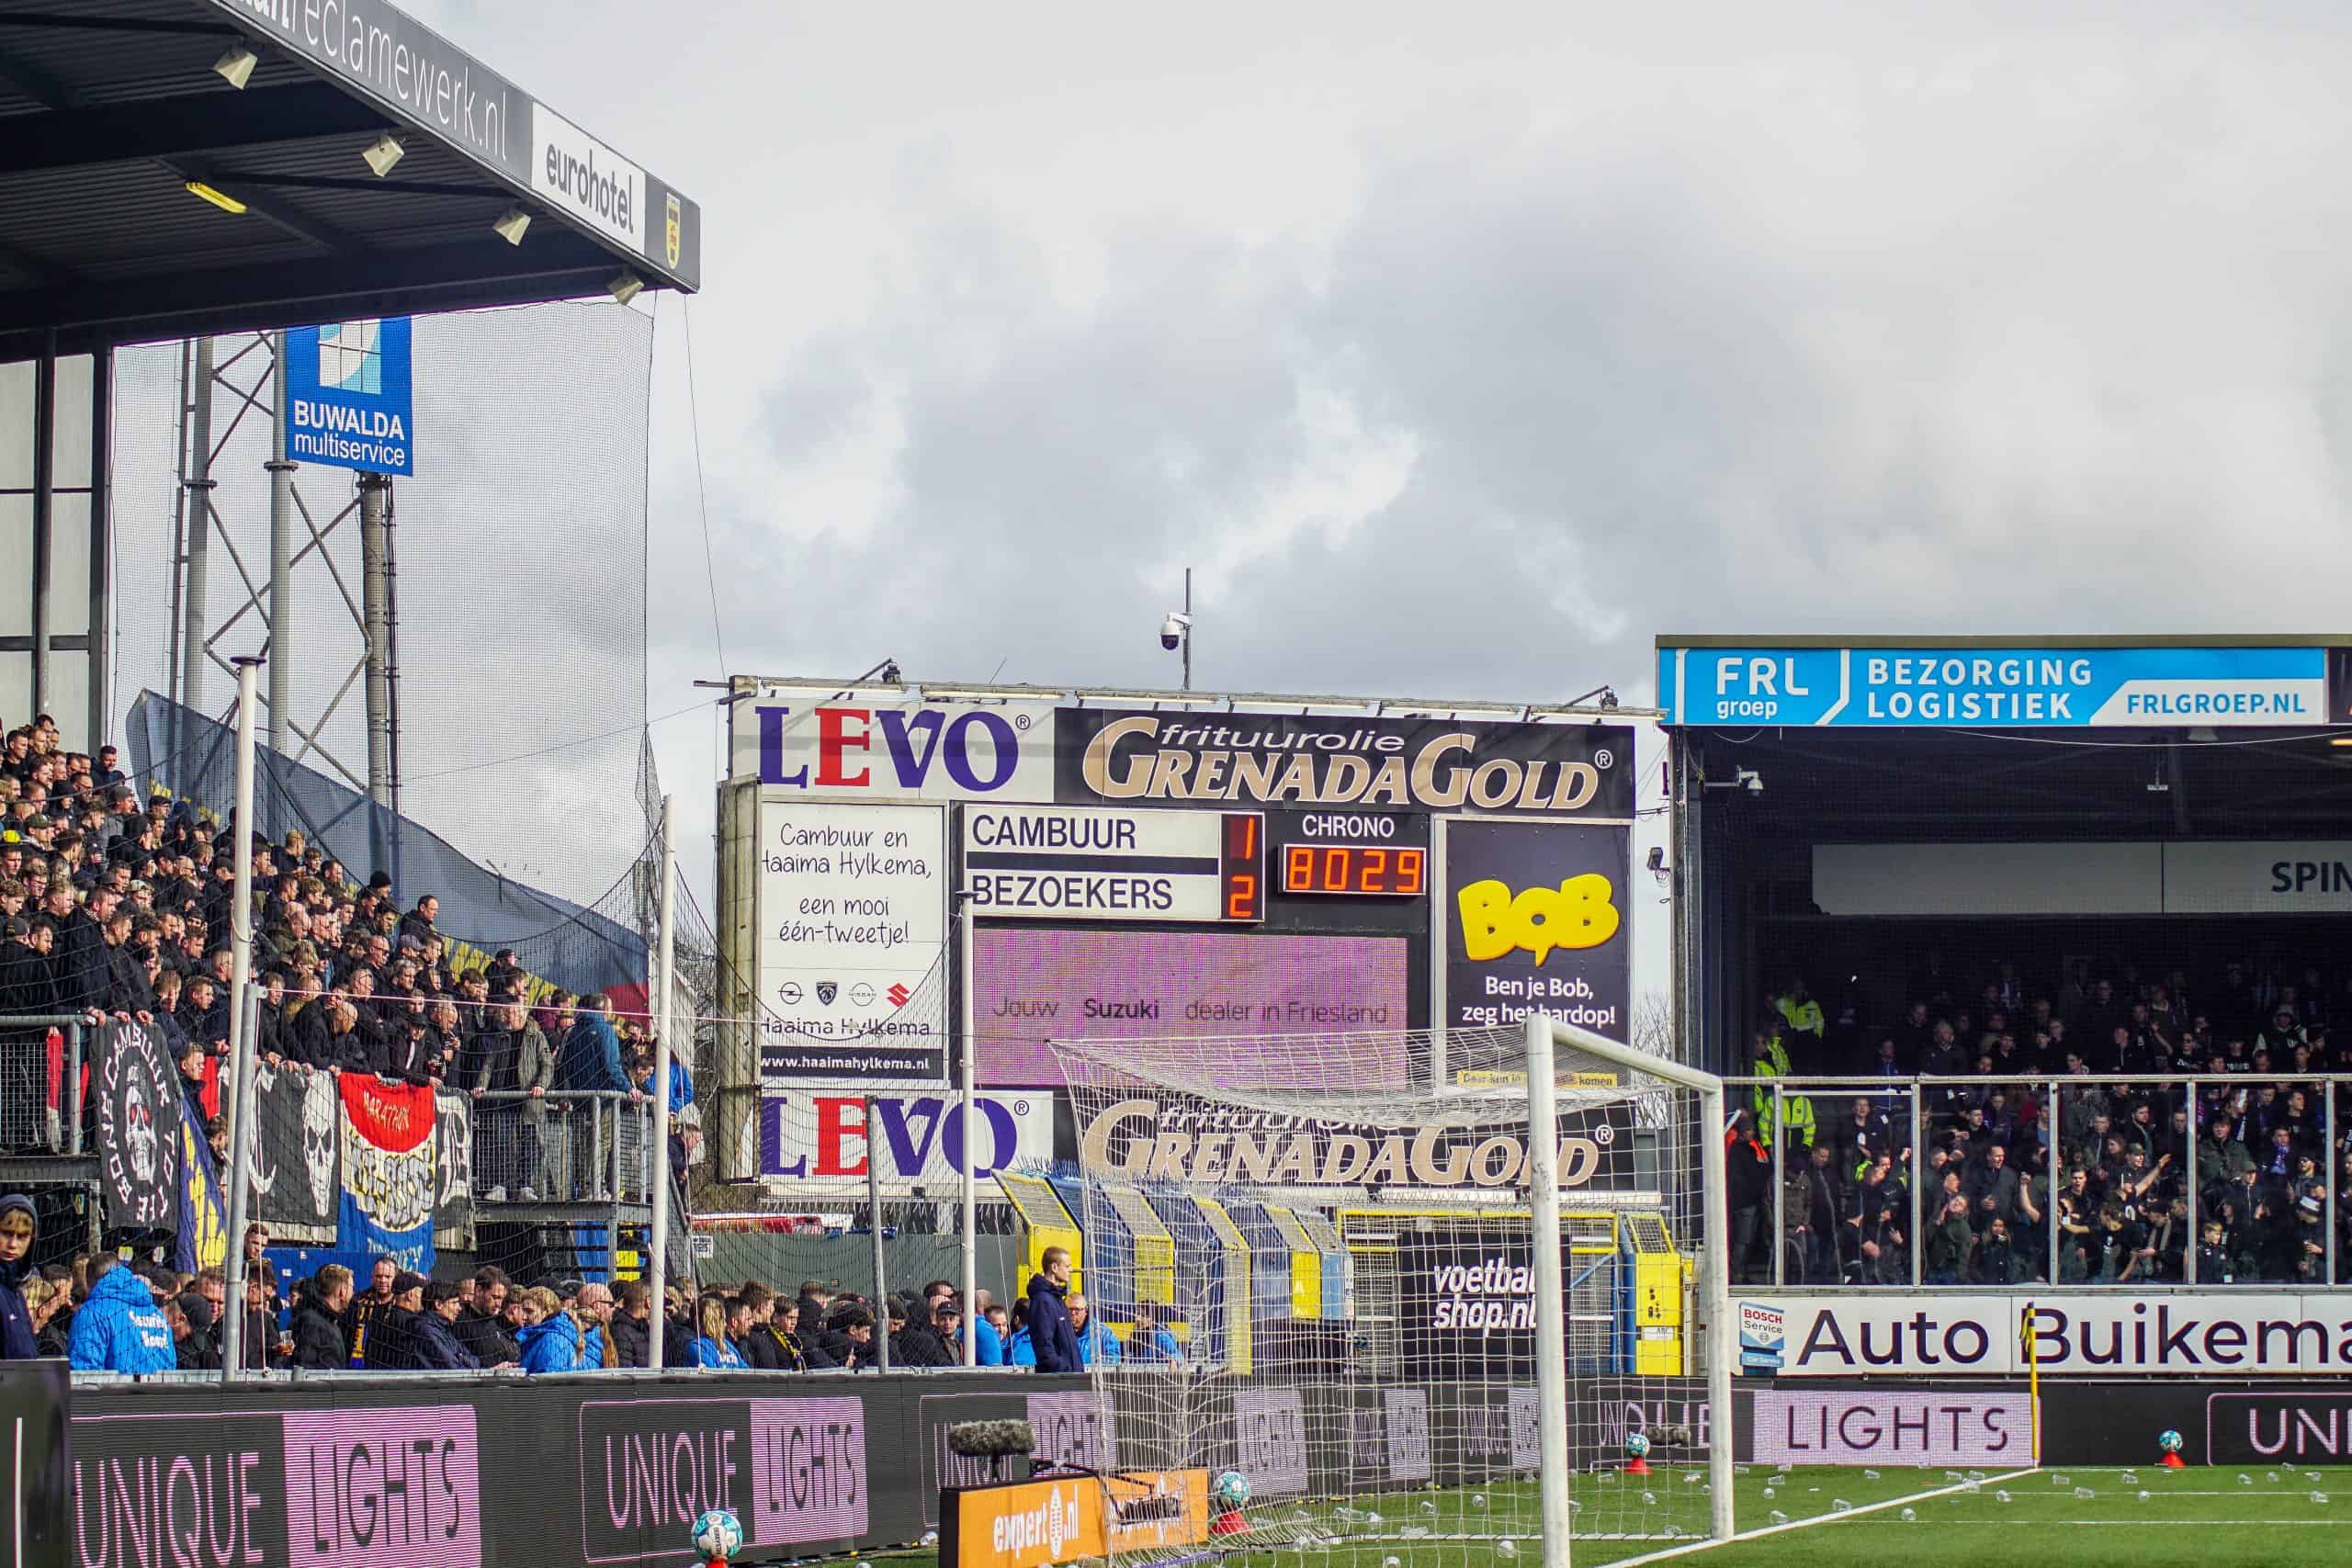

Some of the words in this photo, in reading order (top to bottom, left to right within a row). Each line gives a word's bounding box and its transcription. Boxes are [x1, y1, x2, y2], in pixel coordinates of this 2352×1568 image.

[237, 0, 507, 161] reclamewerk.nl
[546, 143, 634, 233] eurohotel
[294, 399, 404, 441] BUWALDA
[295, 432, 405, 467] multiservice
[1716, 658, 1809, 695] FRL
[1867, 659, 2093, 686] BEZORGING
[1716, 698, 1778, 720] groep
[1867, 692, 2072, 719] LOGISTIEK
[2126, 694, 2306, 715] FRLGROEP.NL
[1161, 724, 1405, 751] frituurolie
[780, 822, 874, 847] Cambuur
[883, 829, 908, 848] en
[972, 814, 1136, 849] CAMBUUR
[1244, 816, 1255, 861] 1
[1302, 814, 1395, 839] CHRONO
[839, 851, 933, 879] Hylkema,
[799, 897, 835, 915] een
[843, 897, 889, 916] mooi
[972, 874, 1173, 910] BEZOEKERS
[1228, 874, 1255, 918] 2
[779, 919, 910, 949] één-tweetje!
[1485, 976, 1523, 995] Ben
[1526, 976, 1545, 999] je
[1549, 978, 1594, 999] Bob,
[993, 996, 1059, 1018] Jouw
[1083, 998, 1160, 1021] Suzuki
[1184, 999, 1253, 1022] dealer
[1262, 999, 1281, 1021] in
[1287, 1000, 1388, 1025] Friesland
[1462, 1007, 1498, 1025] zeg
[1538, 1004, 1616, 1029] hardop!
[1433, 1294, 1537, 1337] shop.nl
[1744, 1308, 1782, 1324] BOSCH
[1744, 1320, 1783, 1334] Service
[1796, 1309, 1990, 1364] Auto
[1788, 1405, 2008, 1451] LIGHTS
[605, 1430, 738, 1529] UNIQUE
[767, 1424, 857, 1513] LIGHTS
[74, 1451, 264, 1568] UNIQUE
[309, 1438, 459, 1554] LIGHTS
